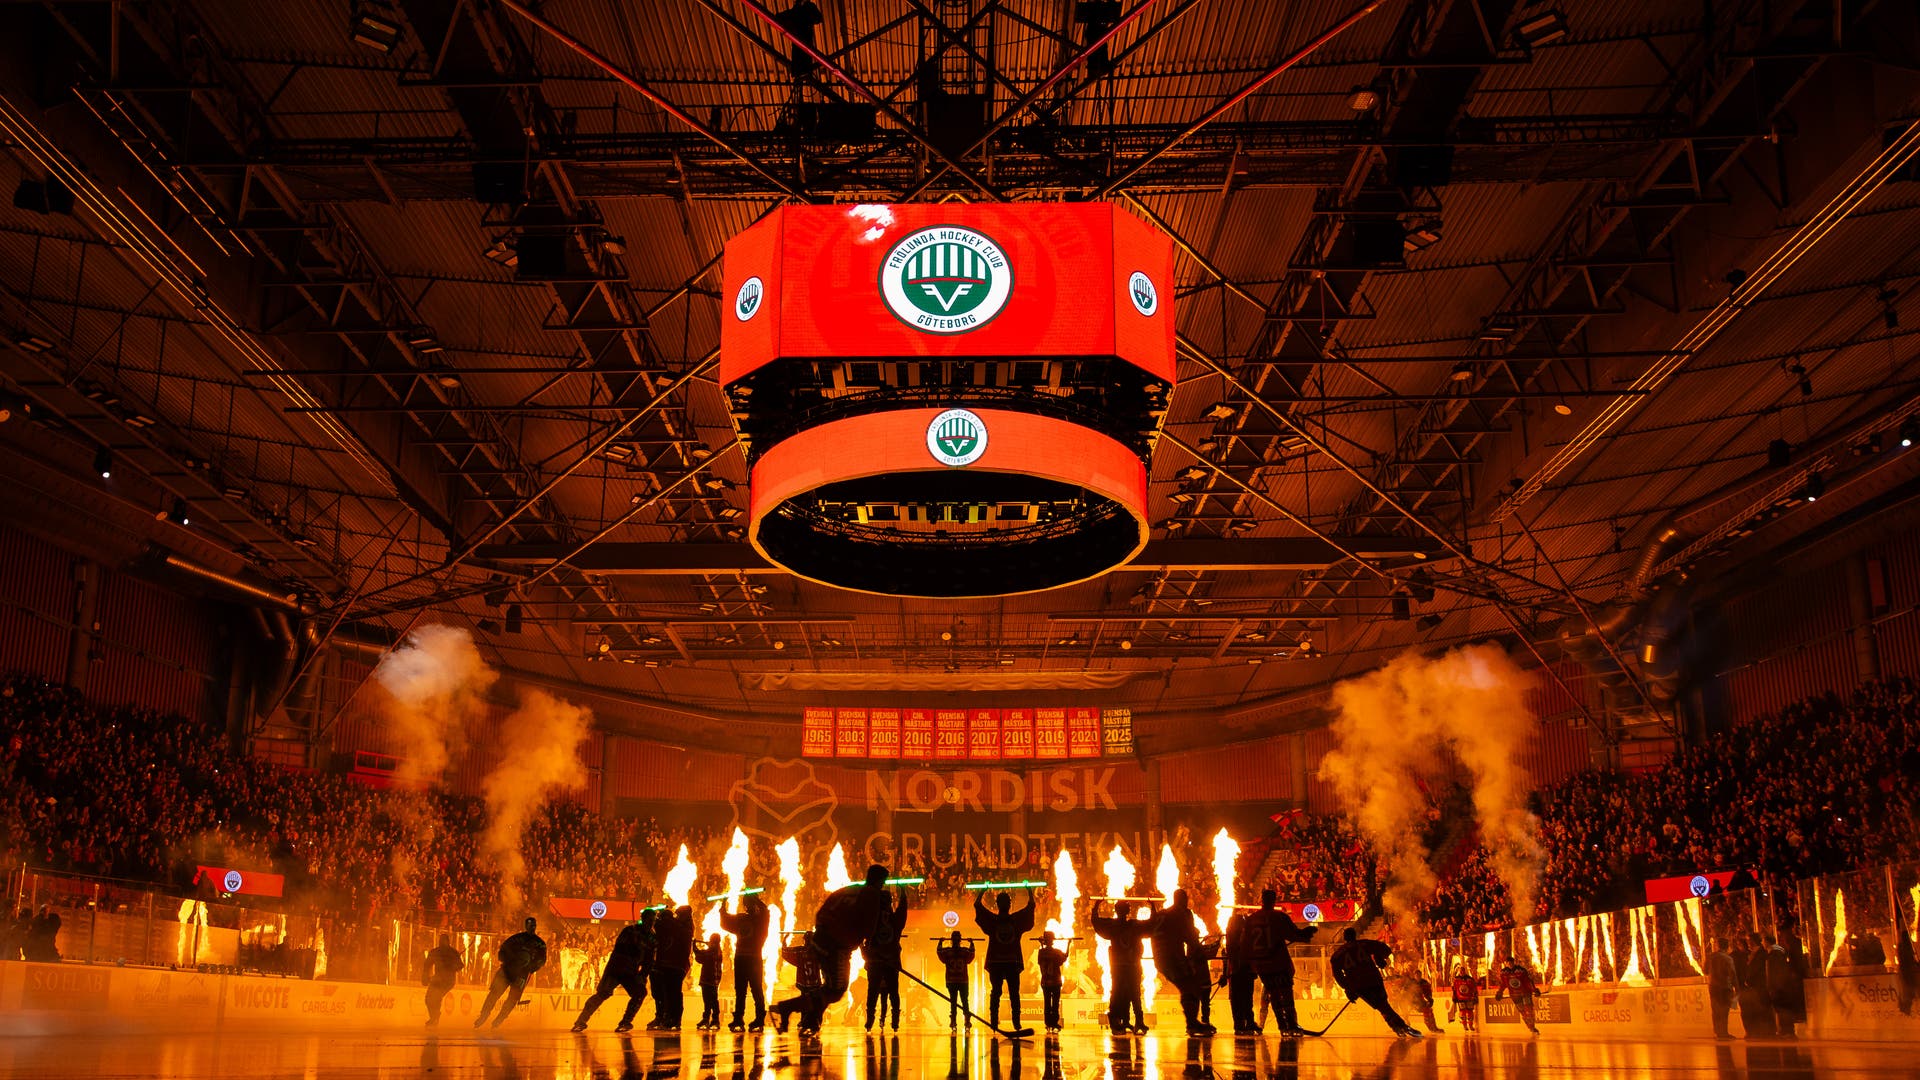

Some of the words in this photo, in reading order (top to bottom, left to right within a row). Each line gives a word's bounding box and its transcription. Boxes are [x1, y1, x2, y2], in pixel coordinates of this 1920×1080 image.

[890, 232, 936, 269] FRÖLUNDA
[940, 231, 983, 248] HOCKEY
[982, 246, 1003, 269] CLUB
[917, 314, 977, 328] GÖTEBORG
[912, 712, 925, 720] CHL
[978, 712, 991, 720] CHL
[805, 729, 831, 743] 1965
[838, 730, 865, 743] 2003
[872, 731, 898, 744] 2005
[904, 731, 931, 745] 2016
[938, 731, 965, 745] 2016
[971, 731, 998, 745] 2017
[1004, 731, 1031, 744] 2019
[1038, 730, 1065, 744] 2019
[1071, 730, 1098, 743] 2020
[1104, 729, 1132, 743] 2025
[866, 767, 1119, 812] NORDISK
[302, 1000, 346, 1014] CARGLASS
[549, 995, 584, 1012] VILL
[1488, 1003, 1516, 1017] BRIXLY
[1538, 997, 1550, 1009] ONE
[1535, 1009, 1551, 1021] MORE
[1583, 1009, 1632, 1023] CARGLASS
